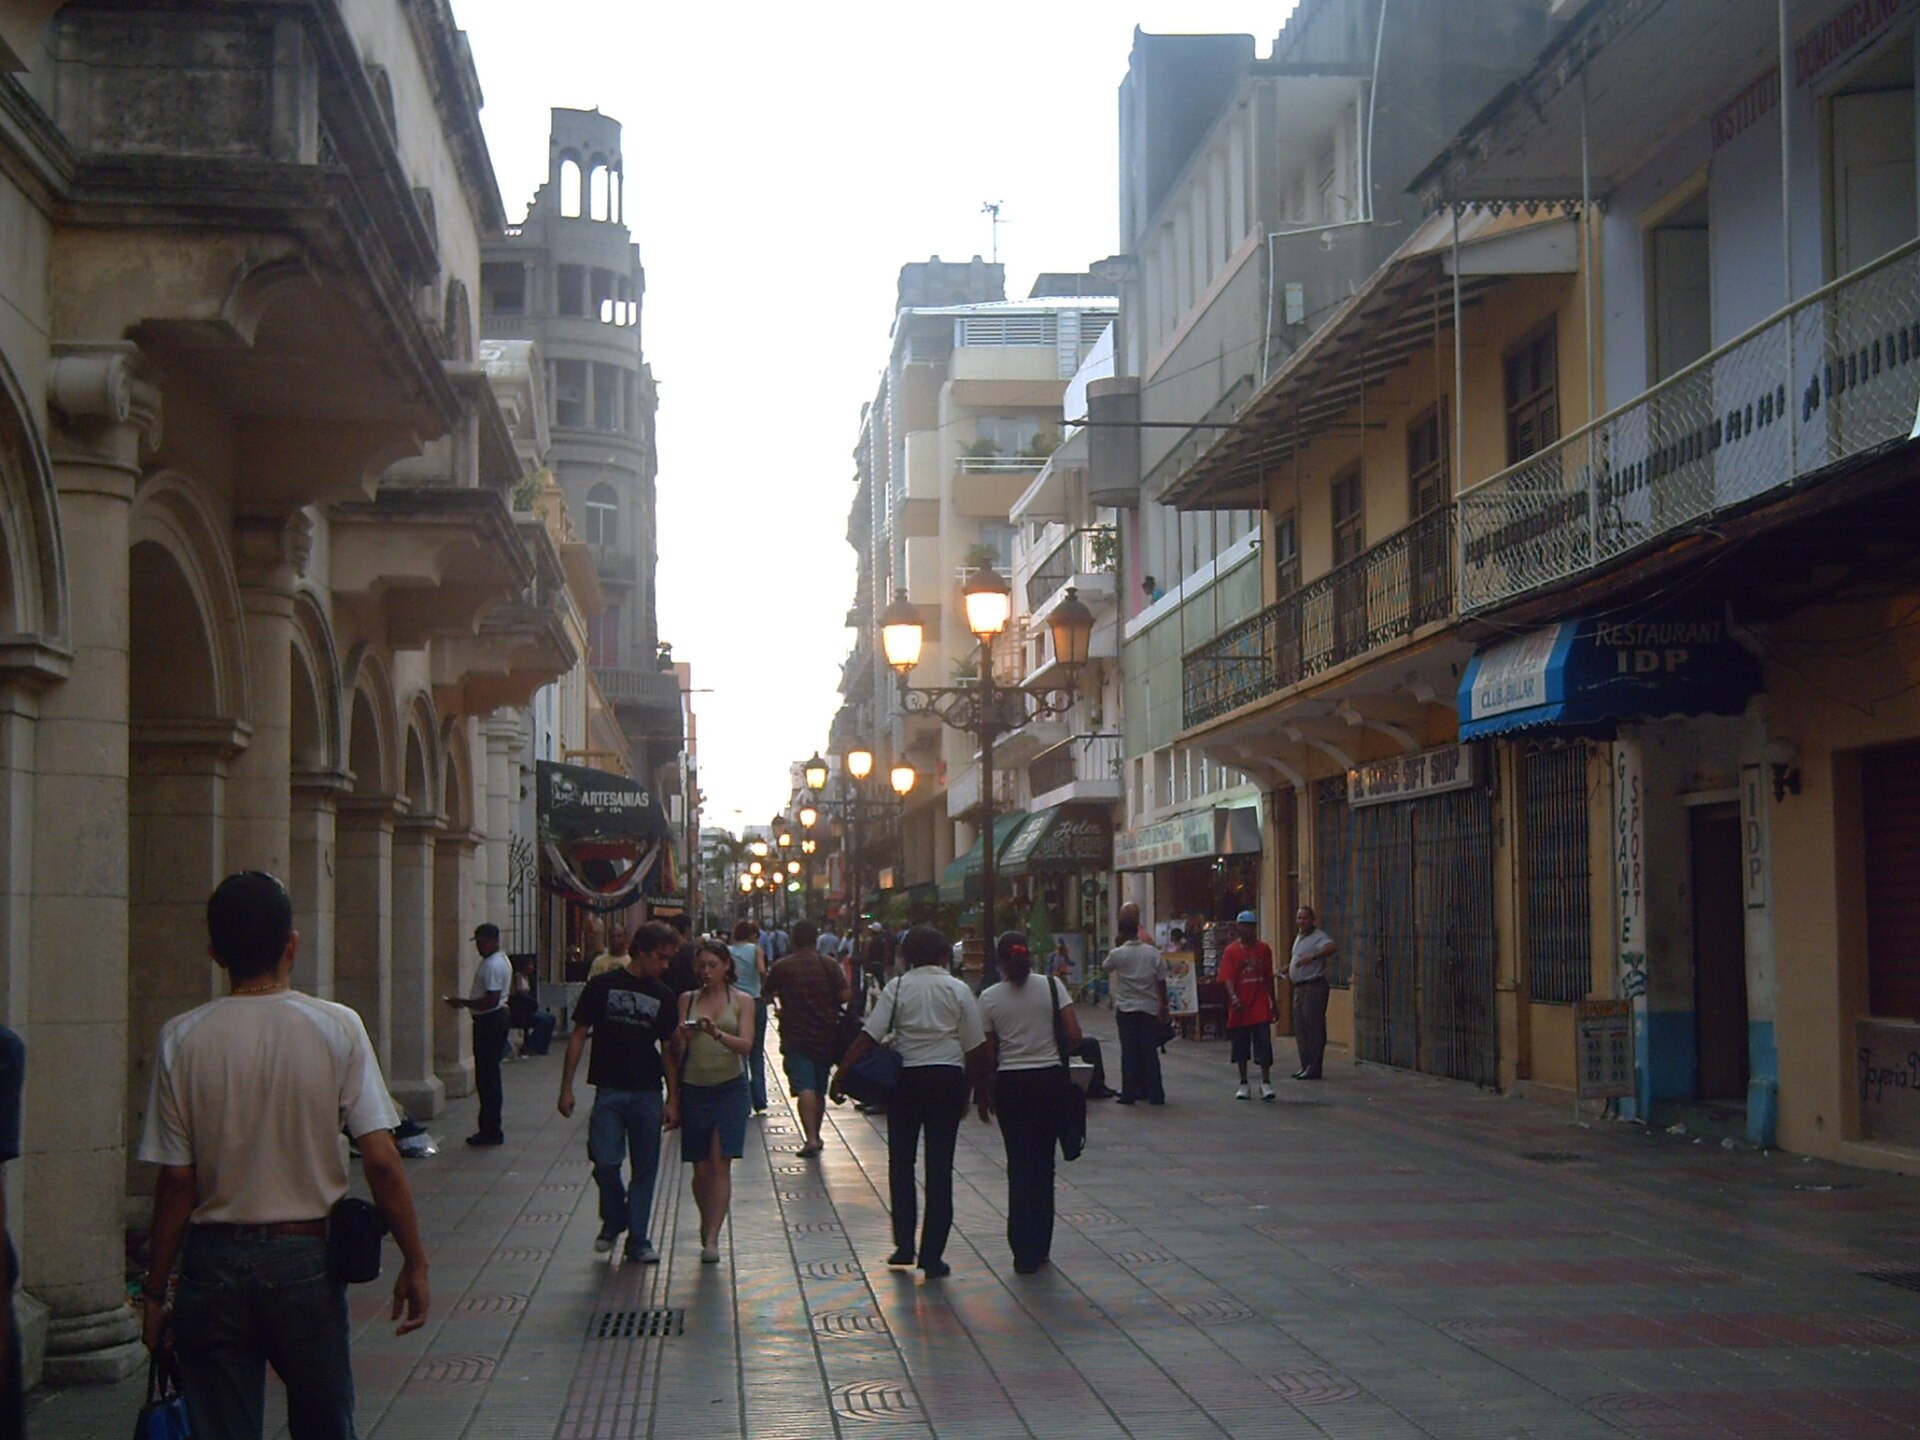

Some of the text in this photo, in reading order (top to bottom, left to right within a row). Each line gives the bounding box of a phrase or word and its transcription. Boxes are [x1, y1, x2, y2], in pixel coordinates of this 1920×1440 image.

[1710, 64, 1778, 151] INSTITUT
[1595, 619, 1723, 647] RESTAURANT
[1616, 649, 1690, 673] IDP
[1480, 678, 1535, 709] CLUB BILLAR
[1430, 747, 1460, 785] SHOP
[580, 790, 650, 808] ARTESANIAS
[1053, 819, 1102, 838] Helen
[1616, 751, 1630, 944] GIGANTE
[1630, 775, 1643, 916] SPORT
[1748, 782, 1762, 891] IDP
[1859, 1047, 1907, 1103] Joyeria
